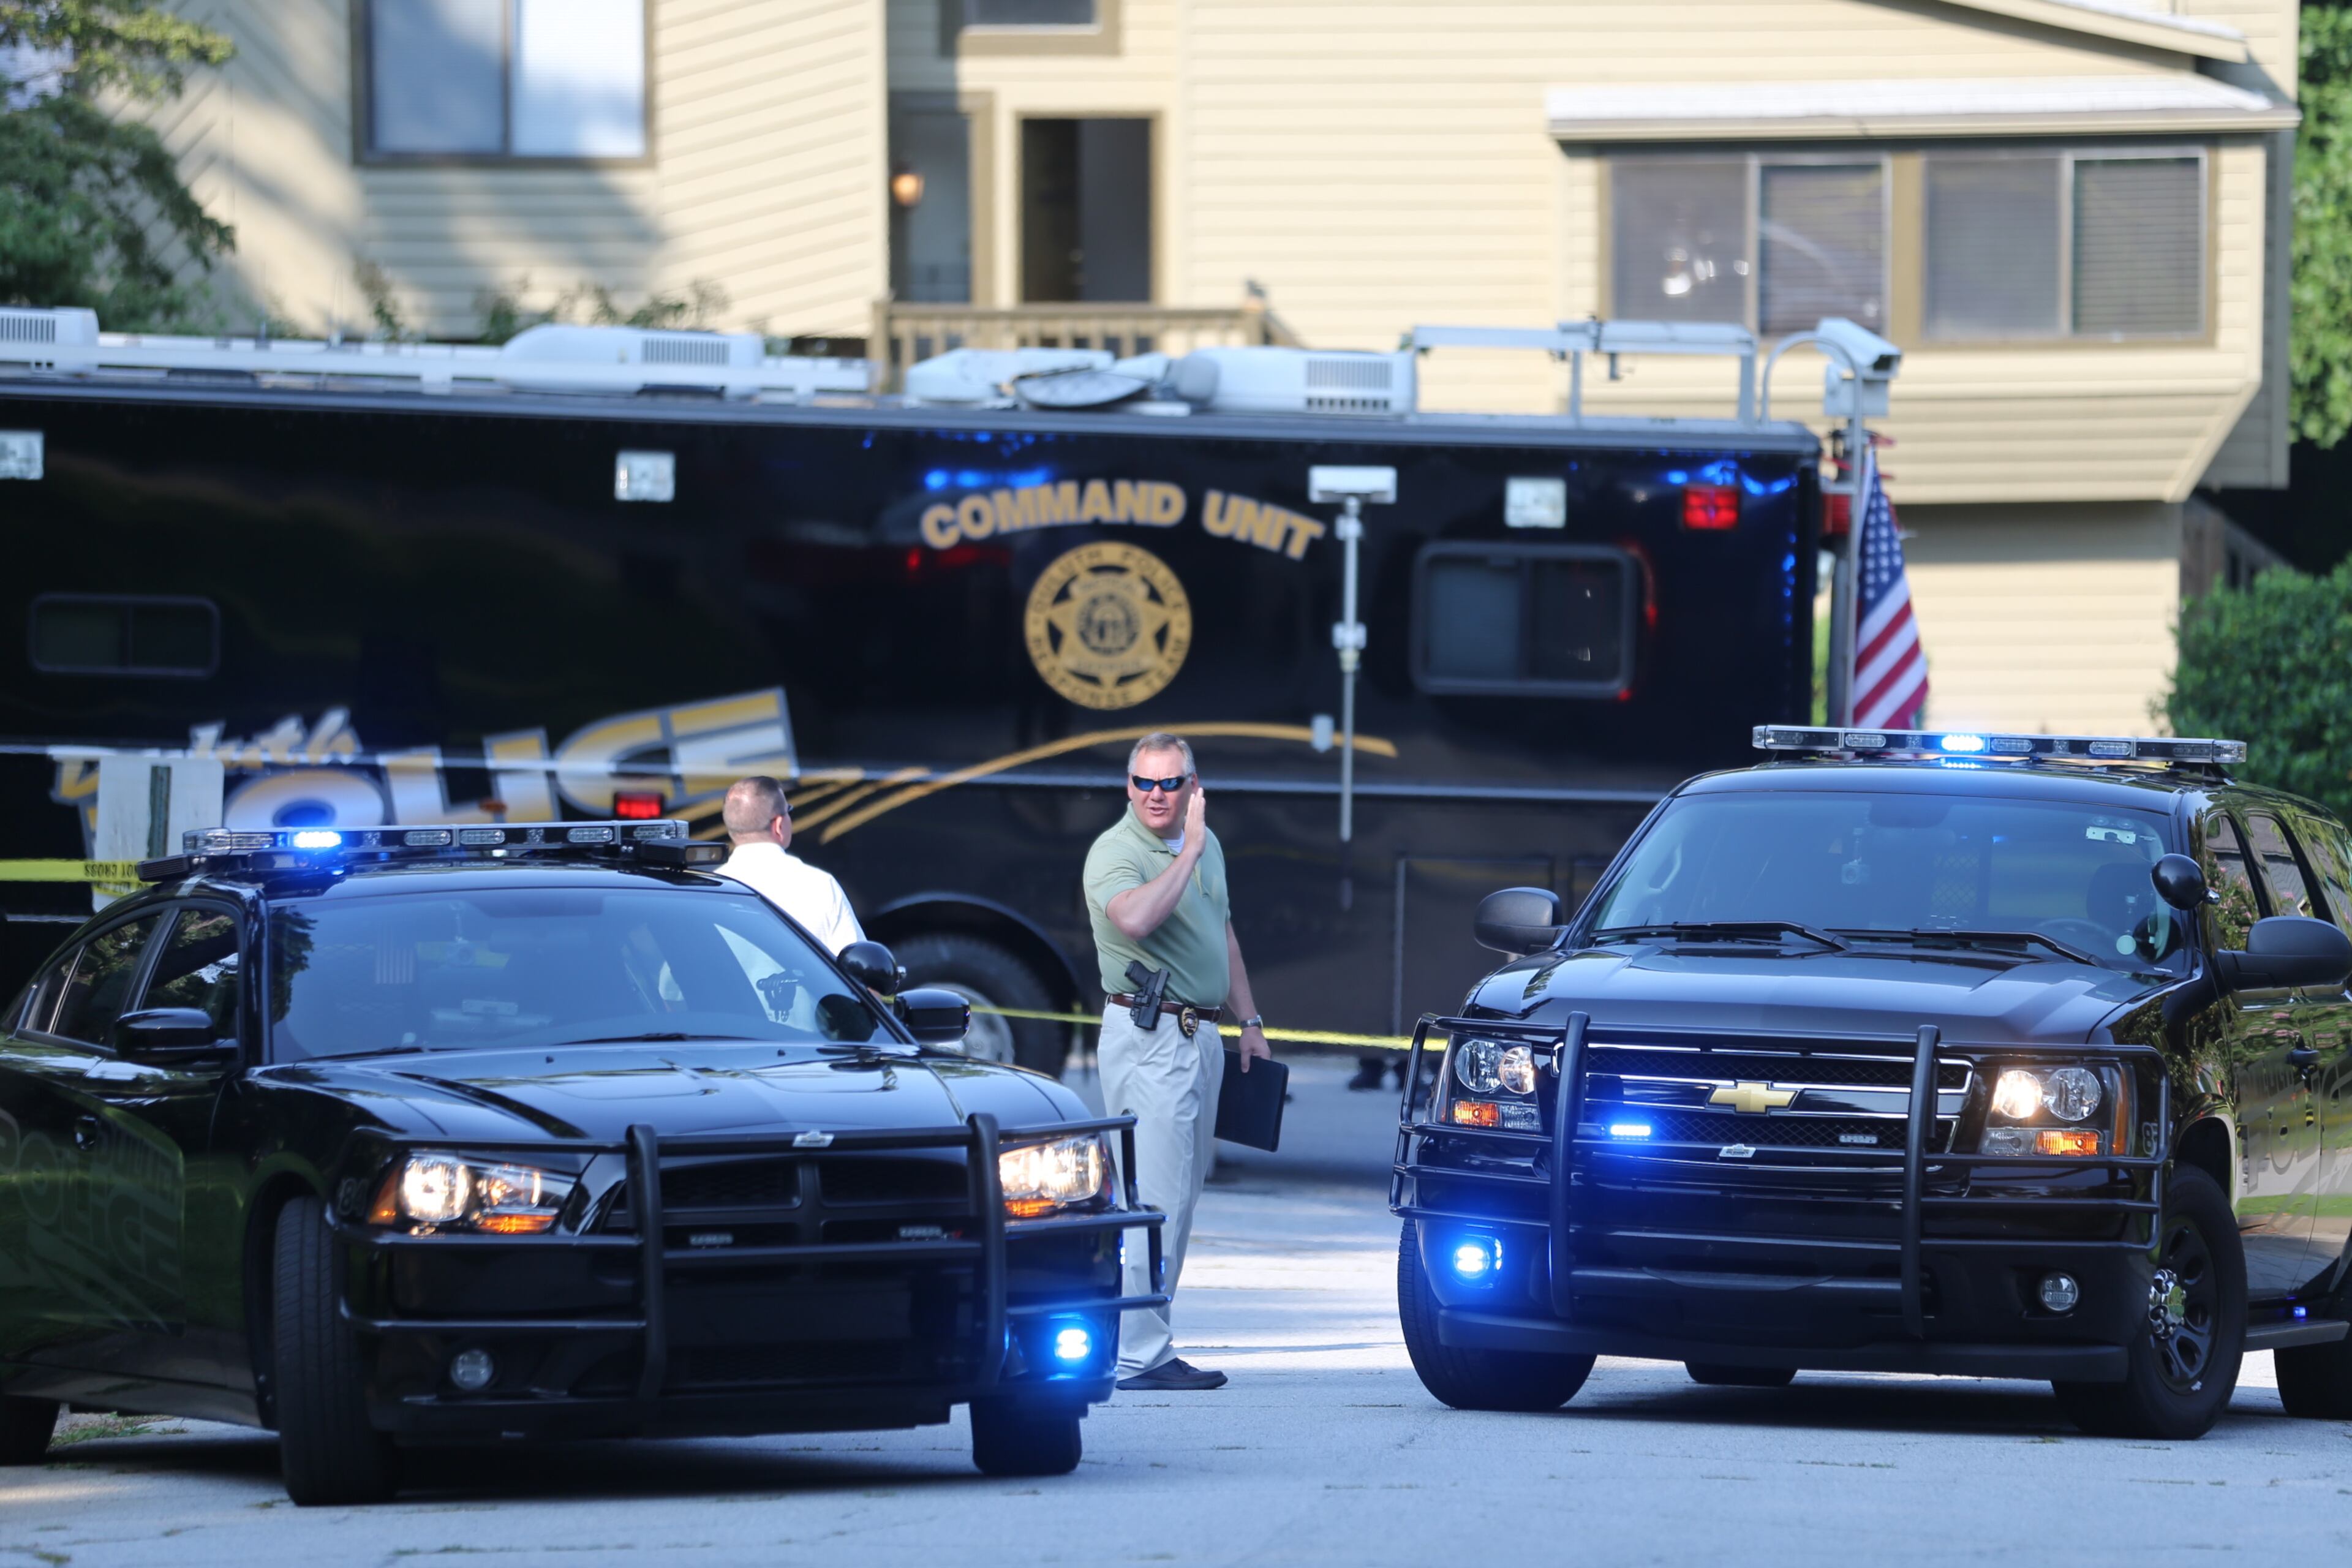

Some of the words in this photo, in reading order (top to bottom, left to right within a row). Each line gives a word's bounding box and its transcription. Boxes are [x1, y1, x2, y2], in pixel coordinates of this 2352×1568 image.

[921, 480, 1186, 549] COMMAND
[1202, 489, 1325, 561] UNIT
[1121, 549, 1183, 610] POLICE
[83, 685, 799, 858] OLICE
[85, 864, 118, 878] CROSS
